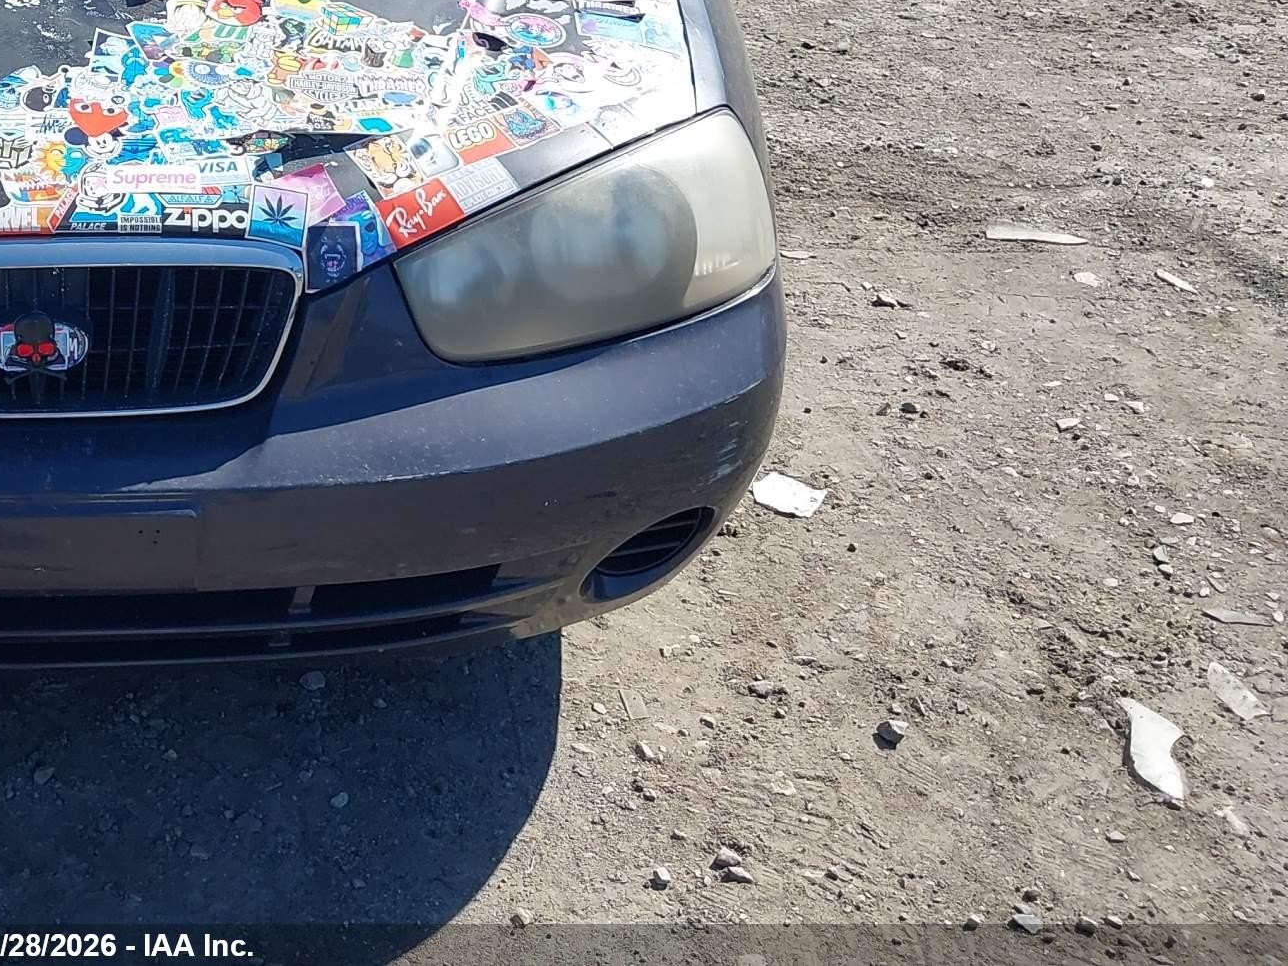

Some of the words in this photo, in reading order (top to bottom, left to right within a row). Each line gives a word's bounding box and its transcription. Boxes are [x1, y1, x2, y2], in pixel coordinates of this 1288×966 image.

[458, 106, 496, 122] FACE
[448, 121, 495, 149] LEGO
[198, 161, 238, 173] VISA
[113, 170, 197, 189] Supreme
[168, 195, 214, 203] ALFALFA
[70, 223, 106, 231] PALACE
[120, 224, 128, 232] IS
[129, 224, 161, 232] NOTHING
